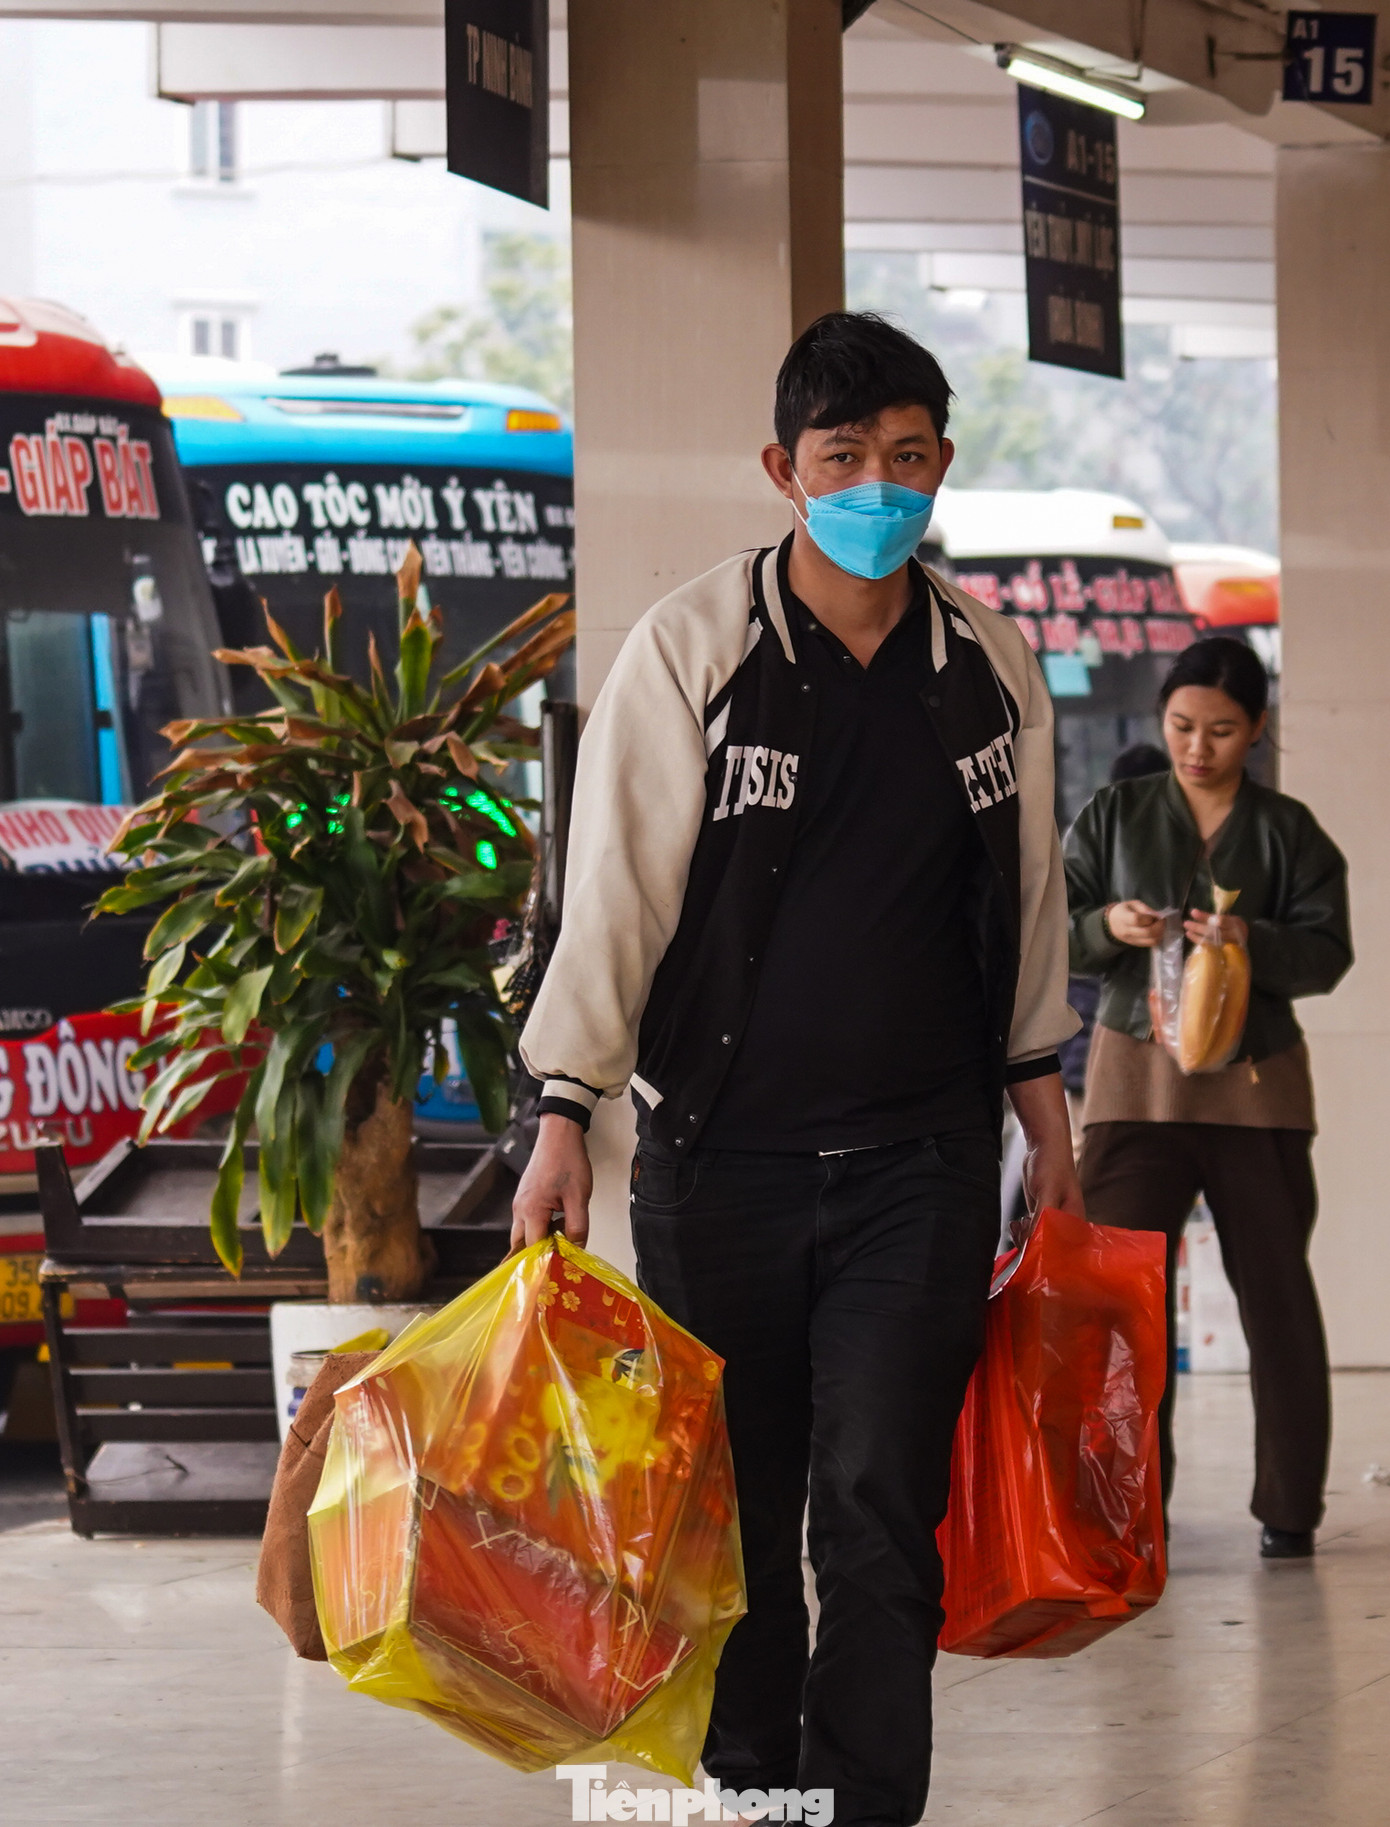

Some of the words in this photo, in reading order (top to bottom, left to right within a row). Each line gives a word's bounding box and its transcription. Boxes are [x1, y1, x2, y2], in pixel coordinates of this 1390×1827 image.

[466, 23, 480, 85] TP
[1292, 18, 1319, 39] A1
[1303, 46, 1364, 96] 15
[1066, 128, 1116, 184] A1-15
[9, 417, 93, 517] GIÁP
[93, 423, 160, 521] BÁT
[226, 482, 300, 530] CAO
[473, 478, 540, 535] YÊN
[23, 1018, 146, 1117] ĐÔNG
